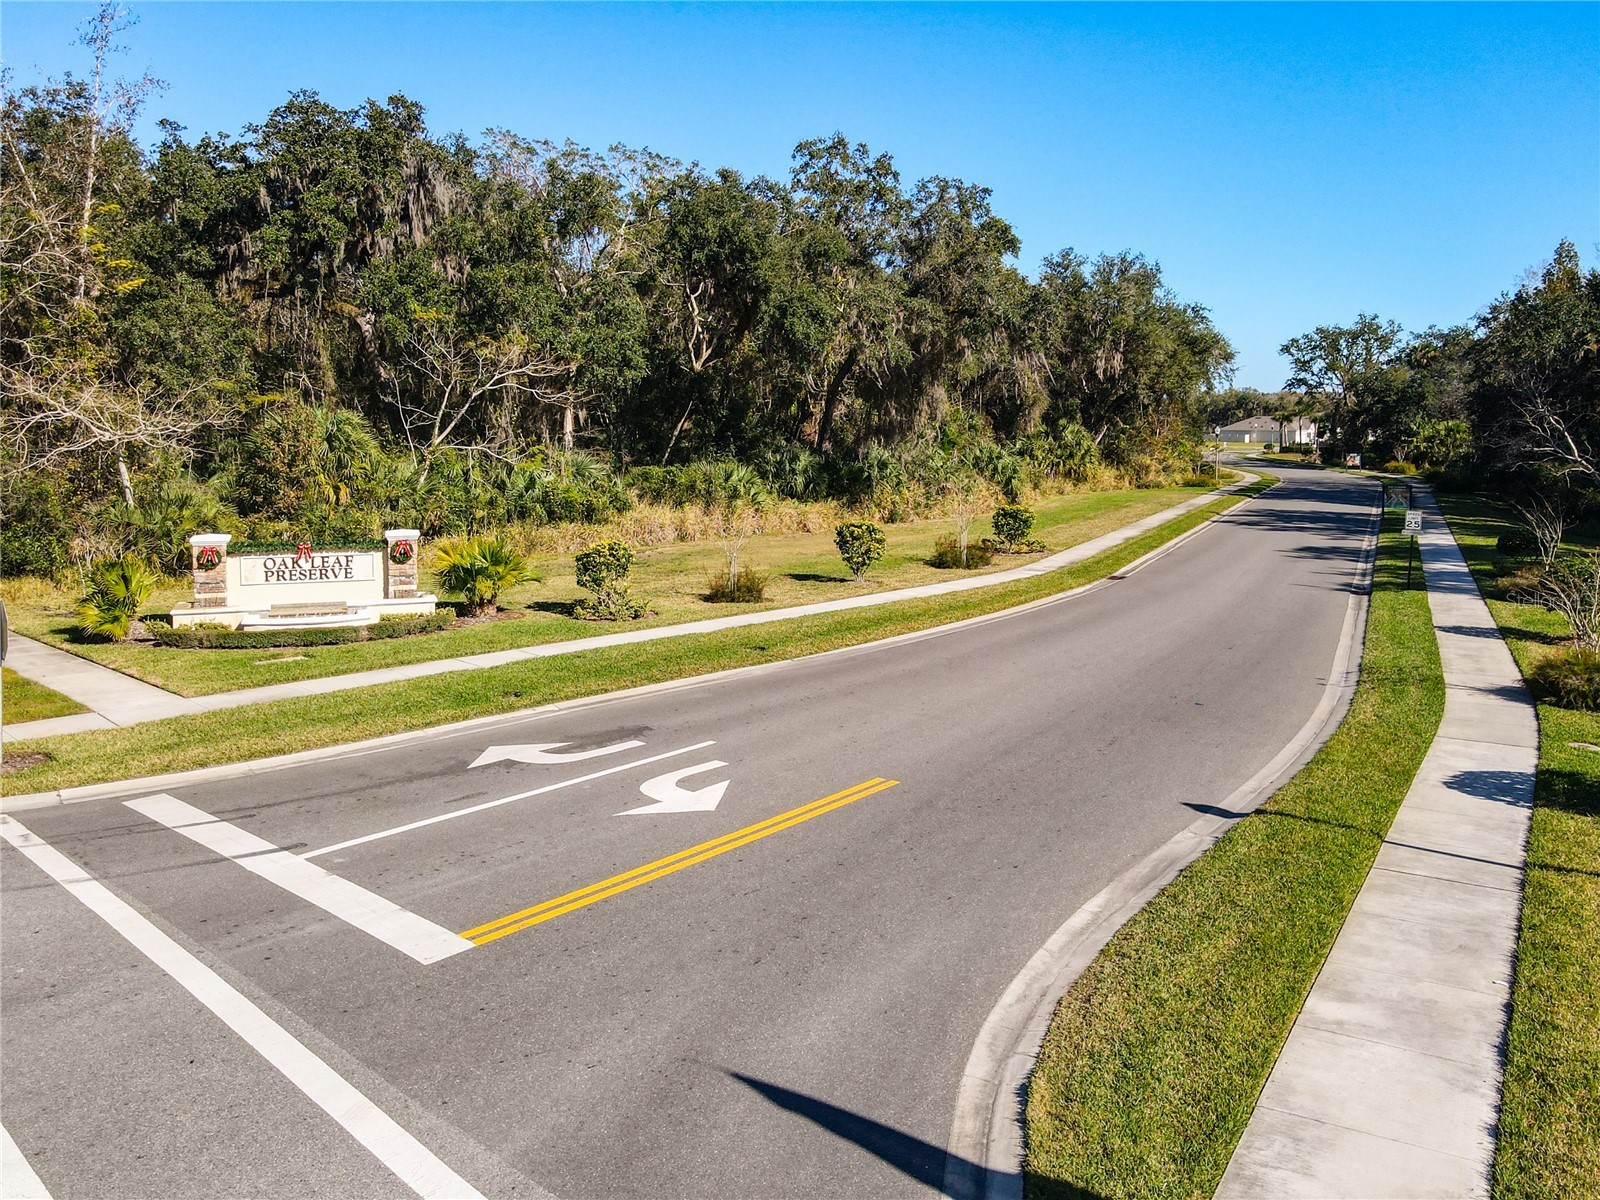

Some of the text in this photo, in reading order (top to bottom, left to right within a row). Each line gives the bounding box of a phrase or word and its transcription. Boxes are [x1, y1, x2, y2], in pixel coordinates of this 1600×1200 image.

[1406, 520, 1420, 528] 25
[263, 555, 353, 569] OAK LEAF
[264, 567, 354, 582] PRESERVE
